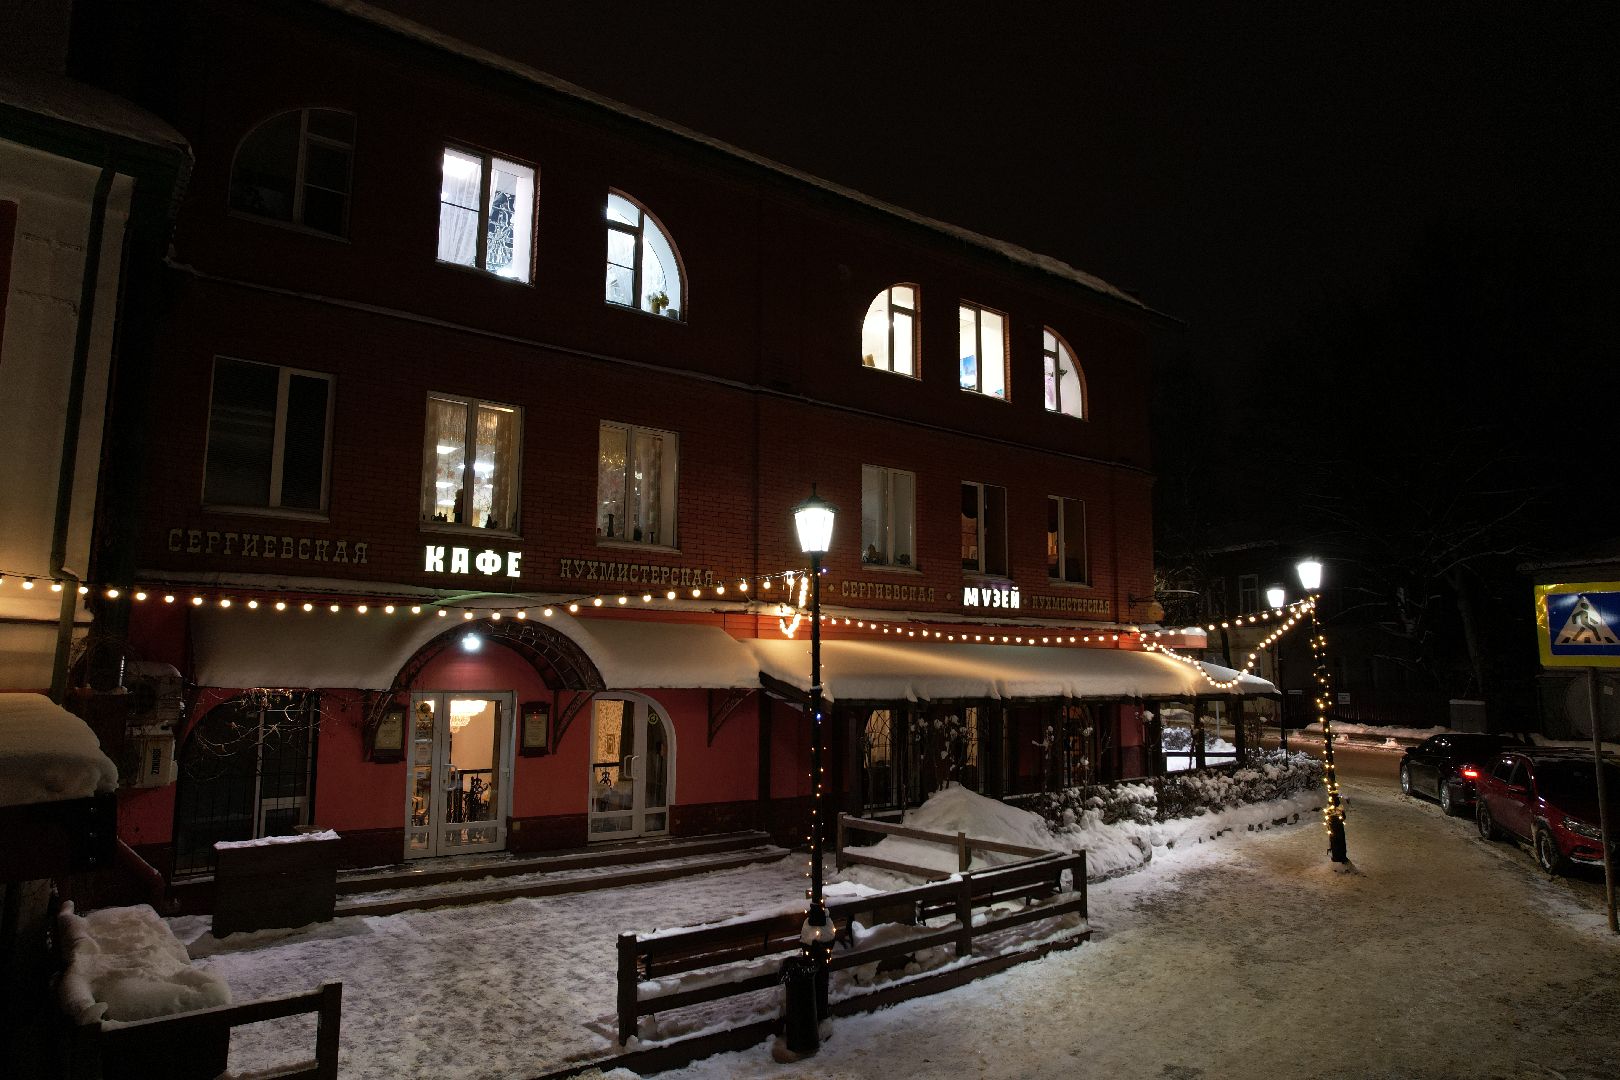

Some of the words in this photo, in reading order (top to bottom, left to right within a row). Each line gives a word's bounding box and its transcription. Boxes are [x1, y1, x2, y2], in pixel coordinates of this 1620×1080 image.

[168, 528, 368, 564] СЕРГИЕВСКАЯ
[425, 545, 523, 578] КАФЕ
[560, 559, 714, 587] КУХМИСТЕРСКАЯ
[841, 580, 935, 602] СЕРГИЕВСКАЯ
[963, 586, 1020, 609] МУЗЕЙ
[1032, 595, 1111, 614] КУХМИСТЕРСКАЯ
